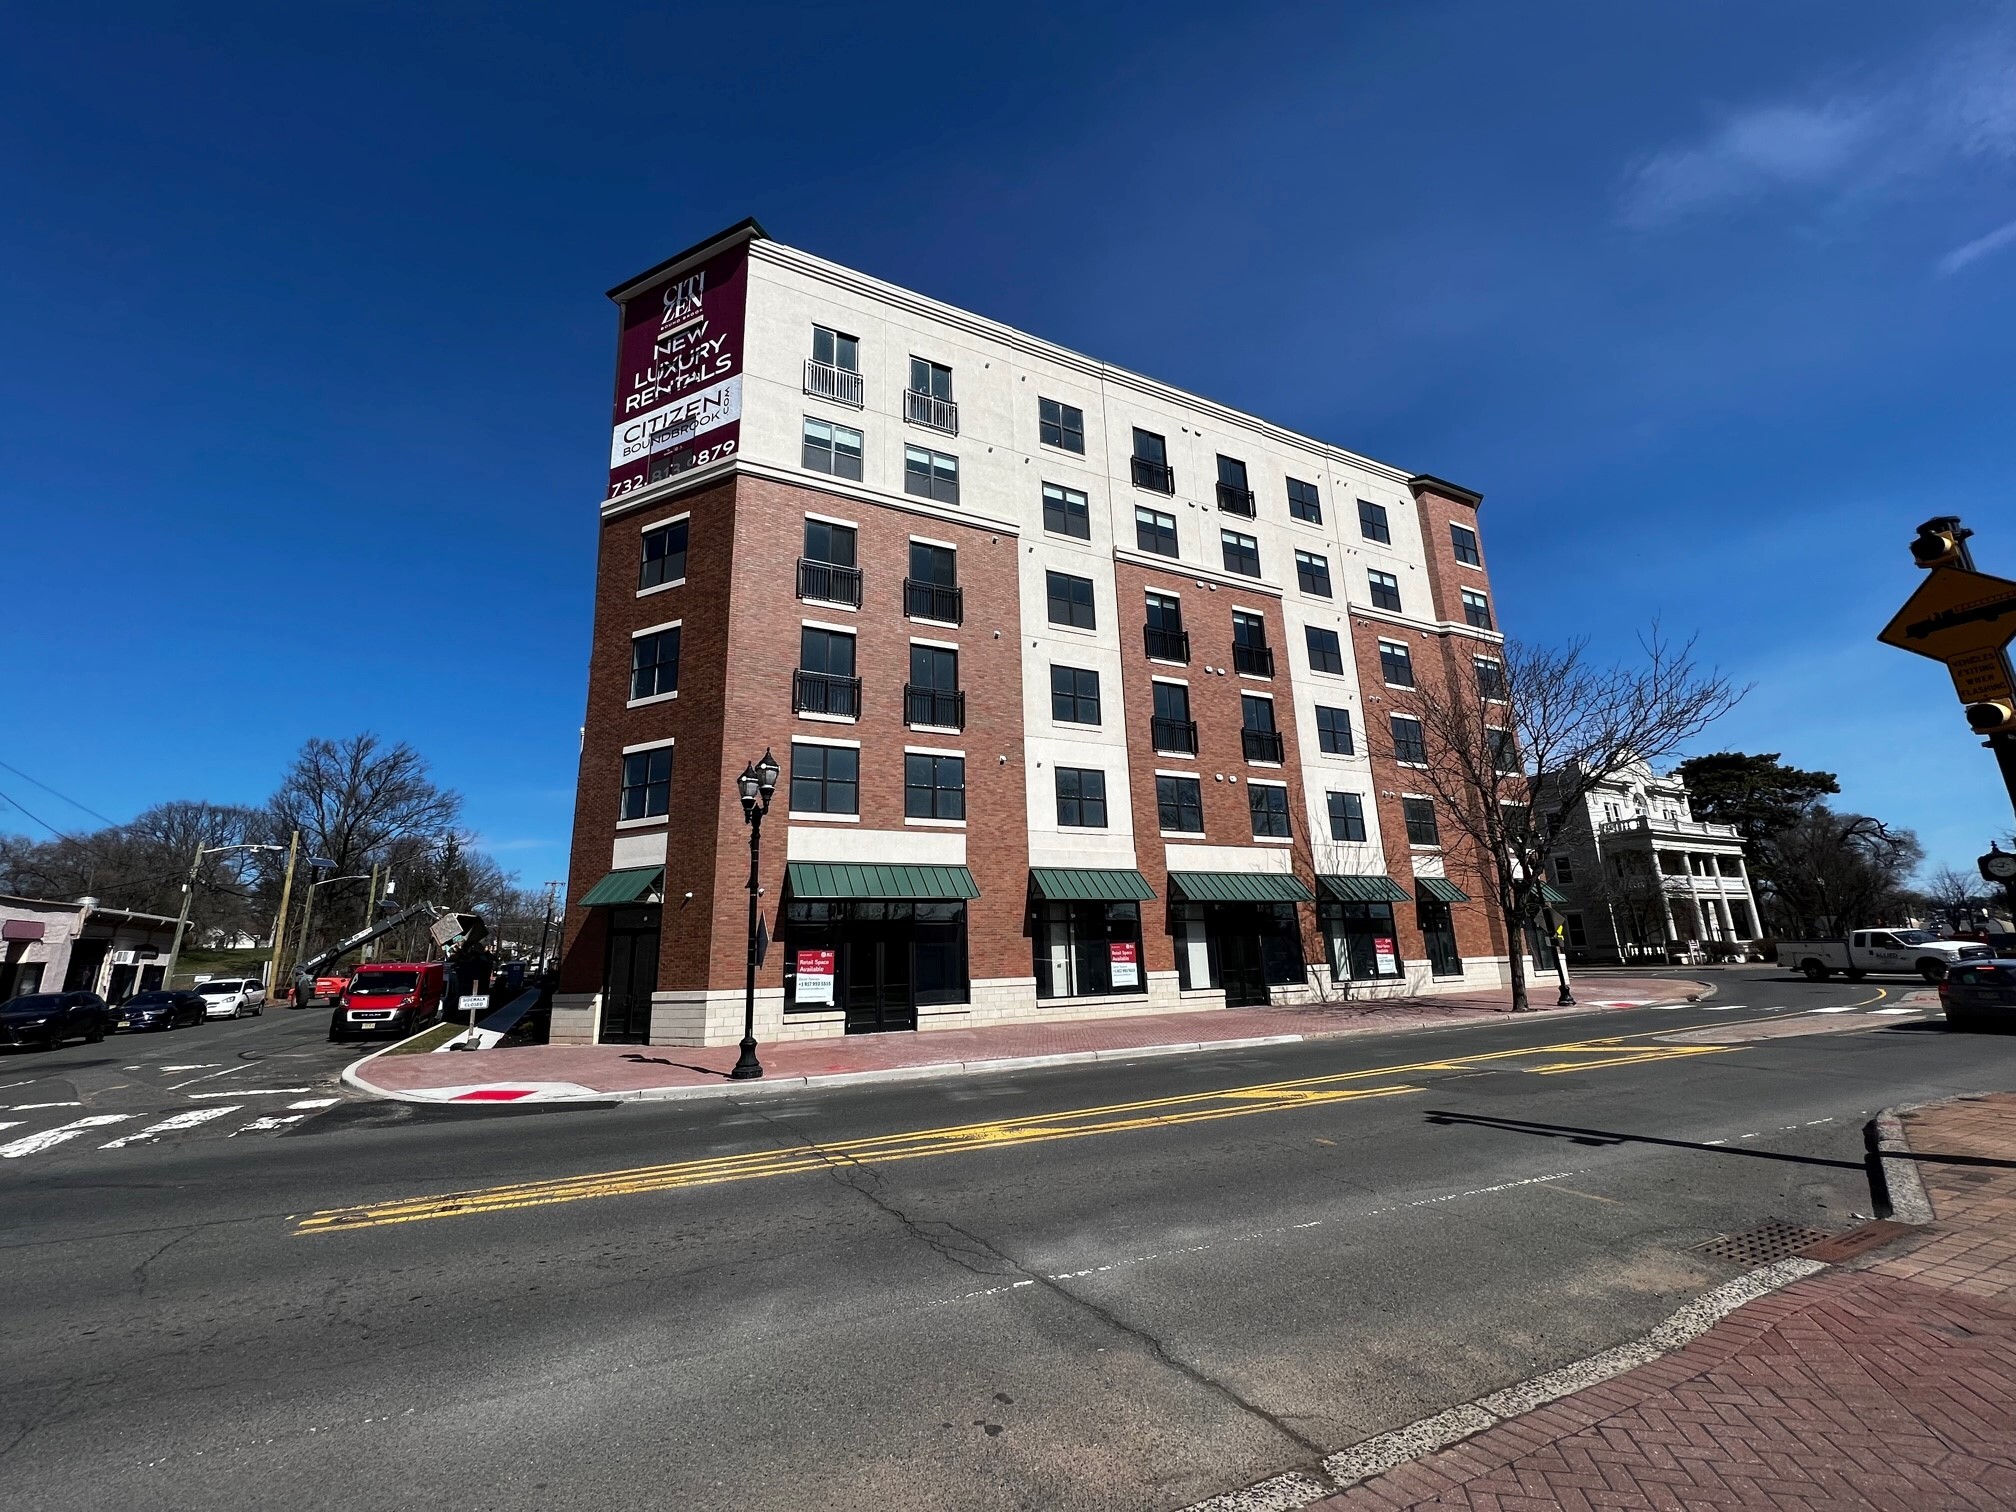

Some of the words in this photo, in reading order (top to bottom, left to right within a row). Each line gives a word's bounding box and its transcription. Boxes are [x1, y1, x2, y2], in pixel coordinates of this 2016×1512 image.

[663, 270, 706, 306] CITI
[660, 318, 681, 331] BOUND
[682, 308, 703, 320] BROOK
[661, 291, 703, 324] ZEN
[654, 320, 709, 360] NEW
[634, 333, 727, 389] LUXURY
[625, 353, 732, 413] RENTALS
[623, 389, 721, 443] CITIZEN
[623, 411, 720, 456] BOUNDBROOK
[1952, 653, 1996, 667] VEHICLES
[1957, 662, 1996, 677] EXITING
[1961, 681, 2007, 697] FLASHING
[1966, 674, 1995, 685] WHEN
